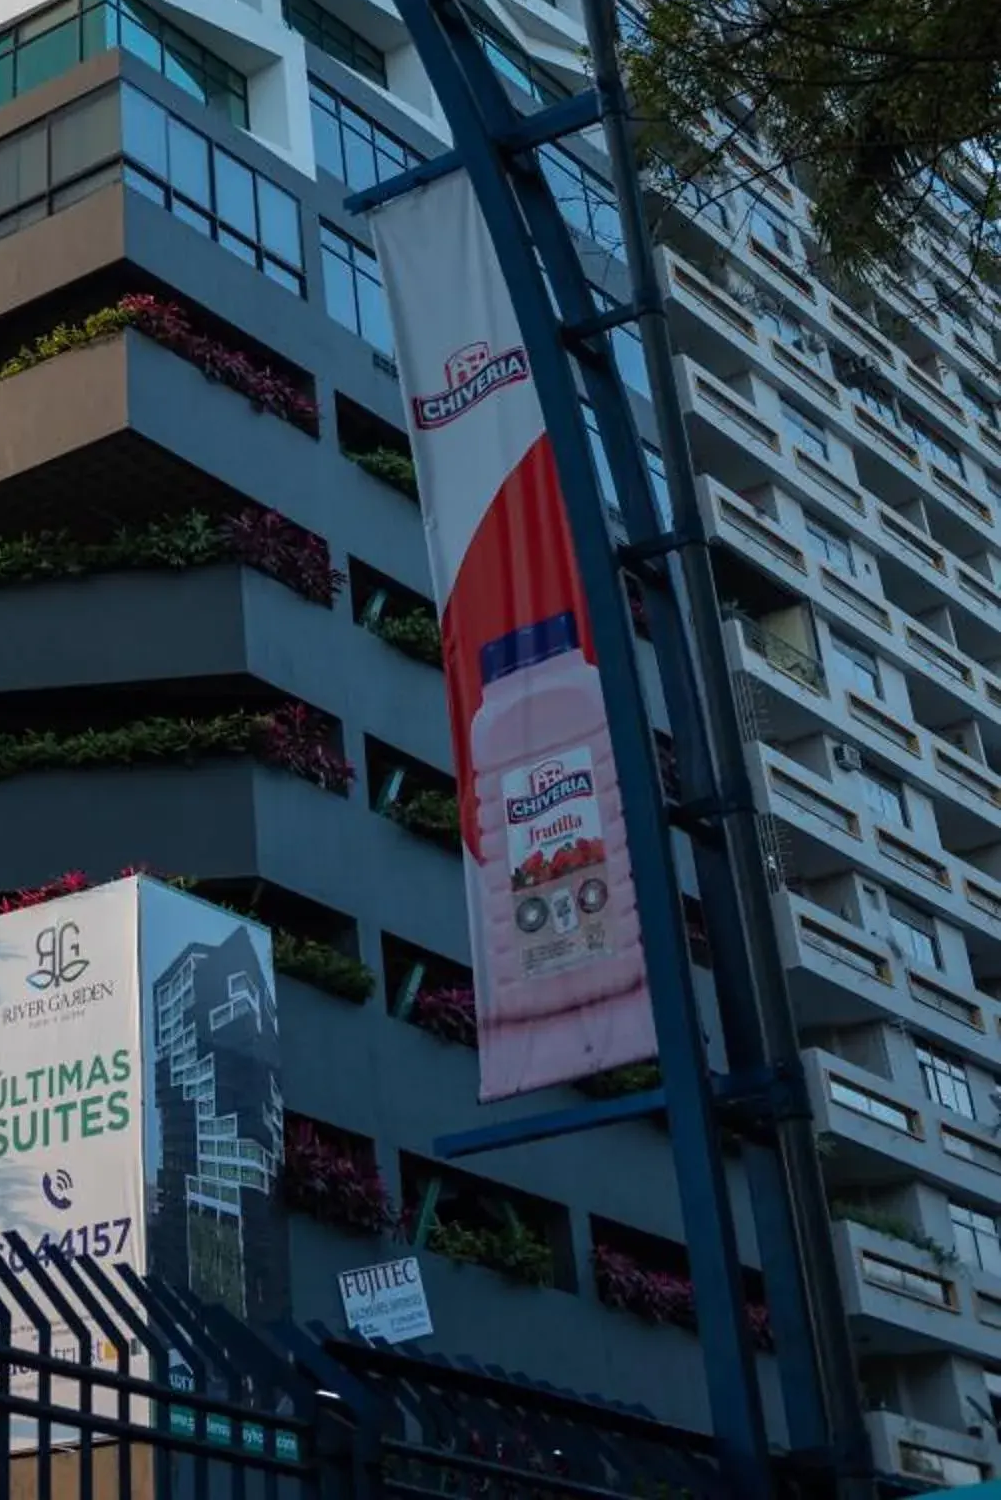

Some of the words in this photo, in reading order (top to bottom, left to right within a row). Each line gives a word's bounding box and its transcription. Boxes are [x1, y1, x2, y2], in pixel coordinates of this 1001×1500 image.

[422, 357, 521, 420] CHIVERIA
[511, 776, 589, 815] CHIVERIA
[529, 815, 582, 845] frutilla
[2, 998, 45, 1026] RIVER
[48, 980, 116, 1012] GARDEN
[343, 1260, 416, 1303] FUJITEC
